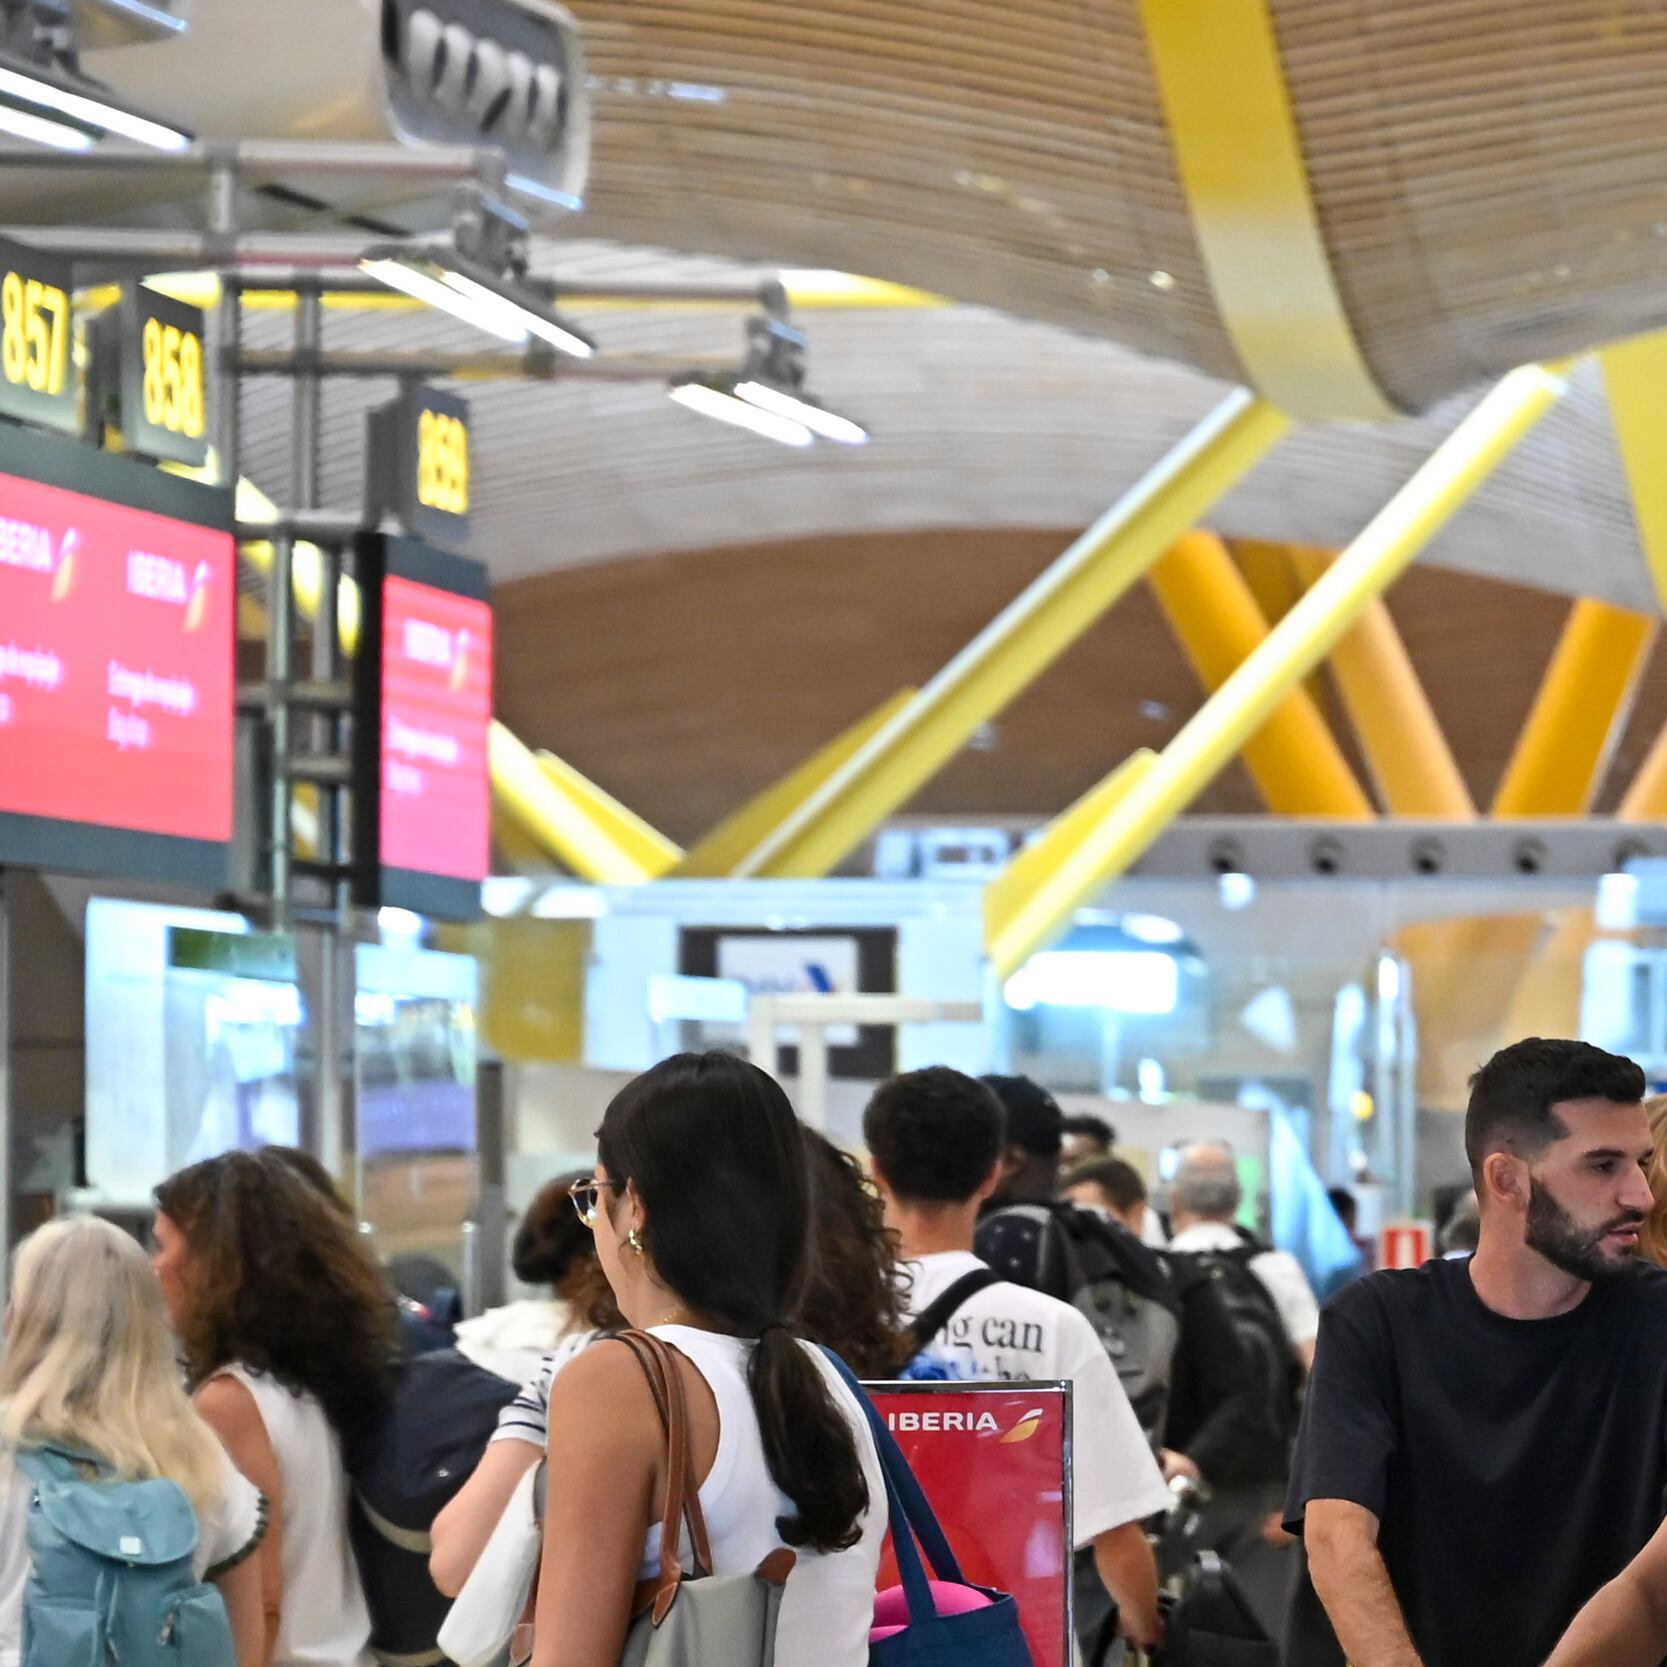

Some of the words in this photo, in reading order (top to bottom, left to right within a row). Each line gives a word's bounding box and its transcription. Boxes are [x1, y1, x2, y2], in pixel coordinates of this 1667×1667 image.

[3, 271, 68, 395] 857
[143, 316, 205, 438] 858
[0, 514, 53, 571] BERIA
[981, 1316, 1043, 1352] can
[888, 1411, 999, 1431] IBERIA
